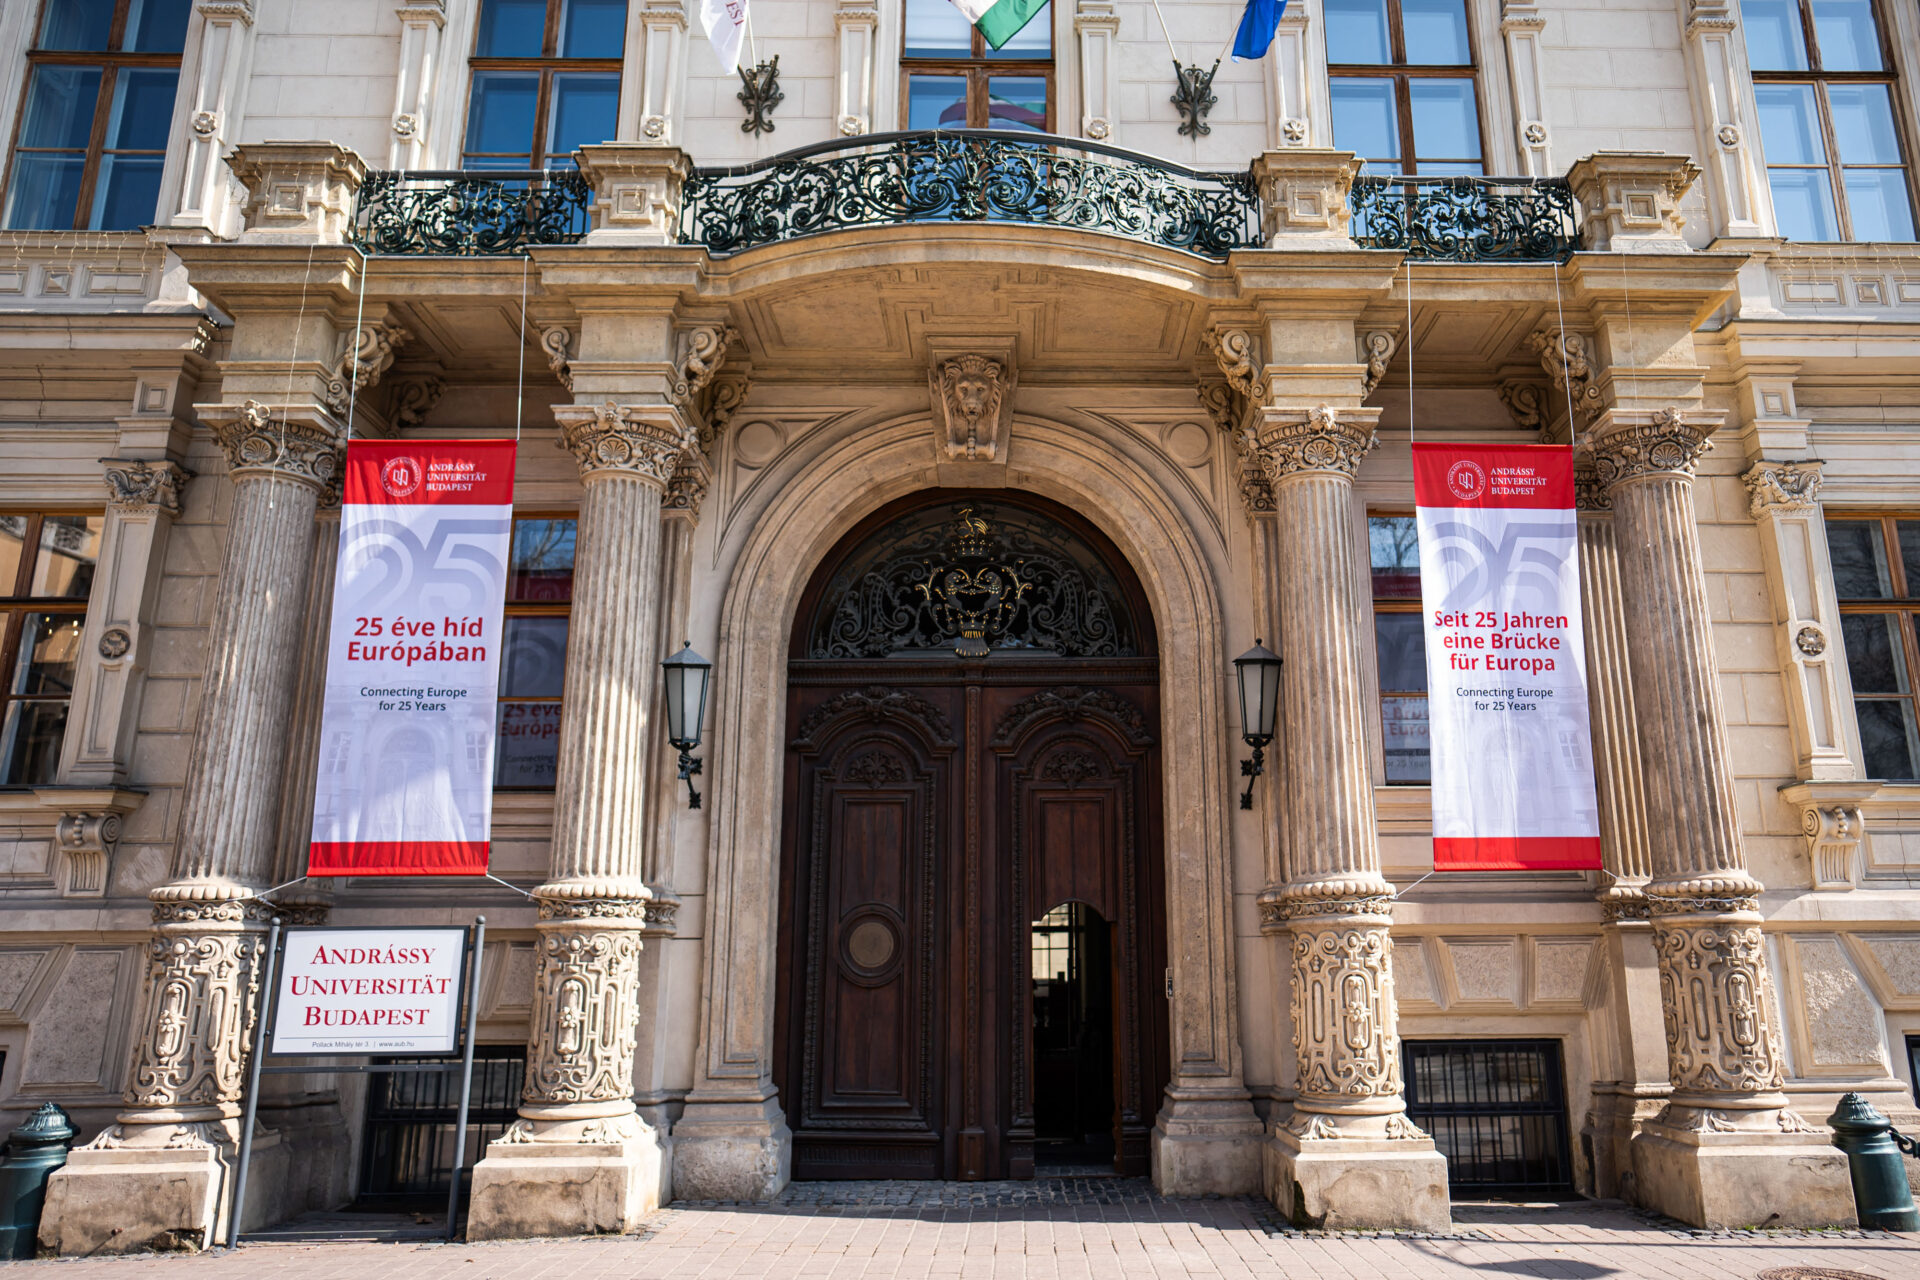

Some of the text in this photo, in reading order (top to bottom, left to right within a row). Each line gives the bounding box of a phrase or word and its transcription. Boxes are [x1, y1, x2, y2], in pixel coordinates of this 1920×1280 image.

[427, 461, 476, 471] ANDRÁSSY
[1491, 466, 1535, 475] ANDRÁSSY
[426, 472, 487, 481] UNIVERSITÄT
[1491, 477, 1547, 486] UNIVERSITÄT
[426, 483, 473, 491] BUDAPEST
[1491, 487, 1536, 495] BUDAPEST
[338, 519, 511, 617] 25
[353, 616, 483, 637] 25 éve híd
[1434, 610, 1569, 632] Seit 25 Jahren
[1443, 632, 1560, 650] eine Brücke
[347, 640, 487, 667] Európában
[1449, 653, 1555, 676] für Europa
[360, 686, 467, 699] Connecting Europe
[1456, 687, 1553, 699] Connecting Europe
[379, 700, 447, 711] for 25 Years
[1474, 700, 1537, 711] for 25 Years
[309, 944, 436, 965] ANDRÁSSY
[290, 974, 452, 996] UNIVERSITÄT
[303, 1006, 430, 1027] BUDAPEST
